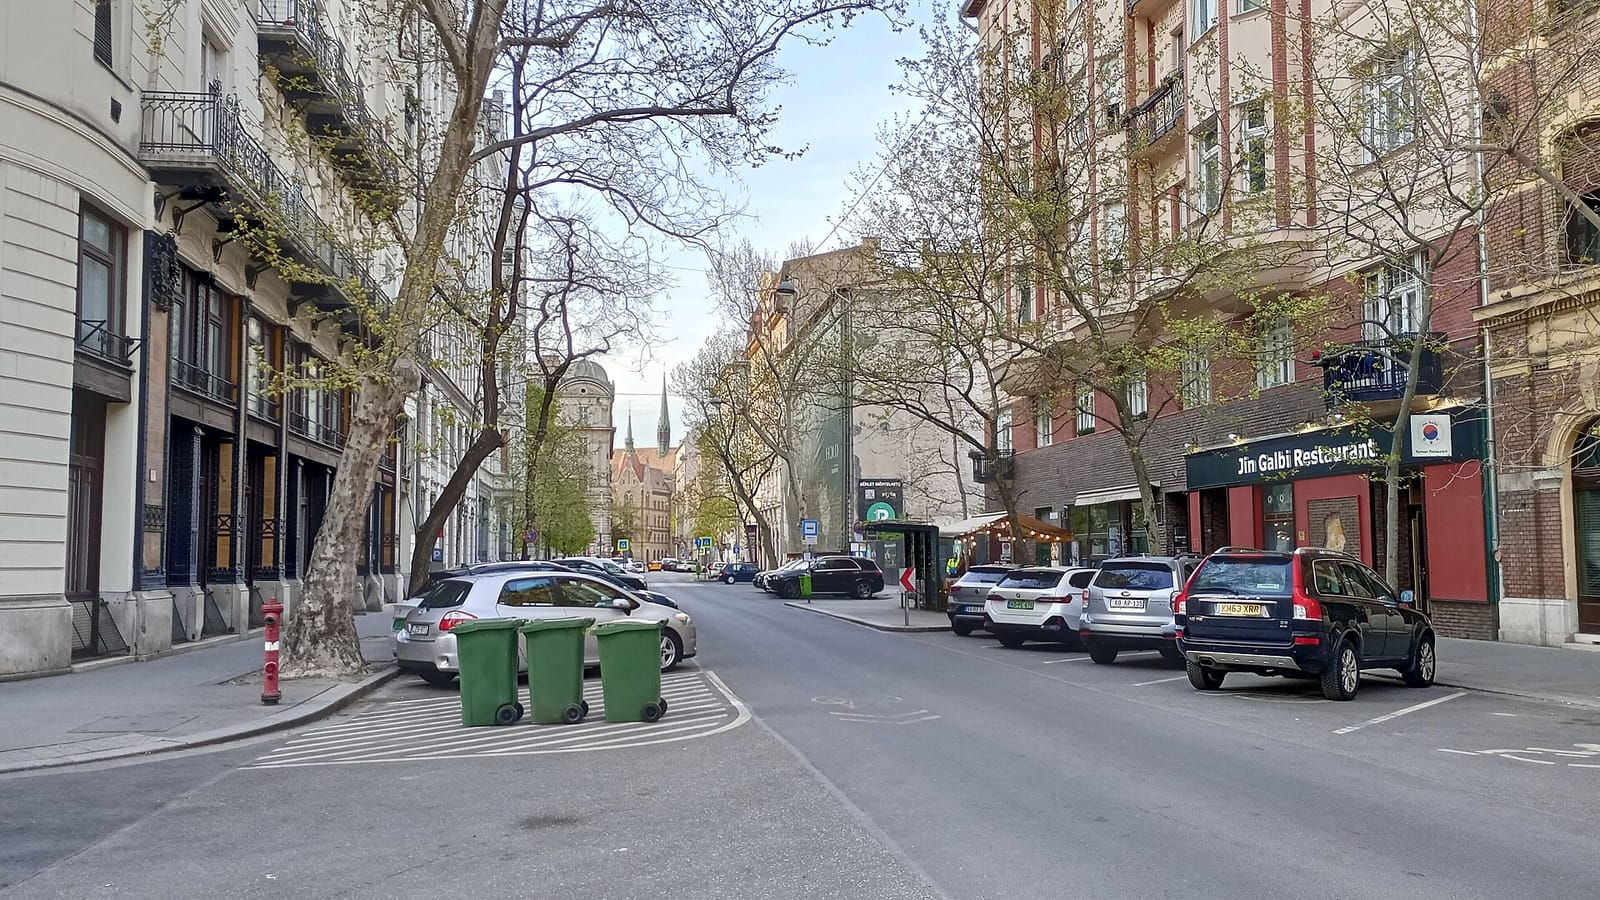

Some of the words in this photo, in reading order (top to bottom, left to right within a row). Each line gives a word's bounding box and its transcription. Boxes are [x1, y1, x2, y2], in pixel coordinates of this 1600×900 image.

[1237, 456, 1257, 475] Jin
[1258, 449, 1291, 472] Galbi
[1294, 438, 1377, 467] Restaurant
[1243, 605, 1260, 614] XRR
